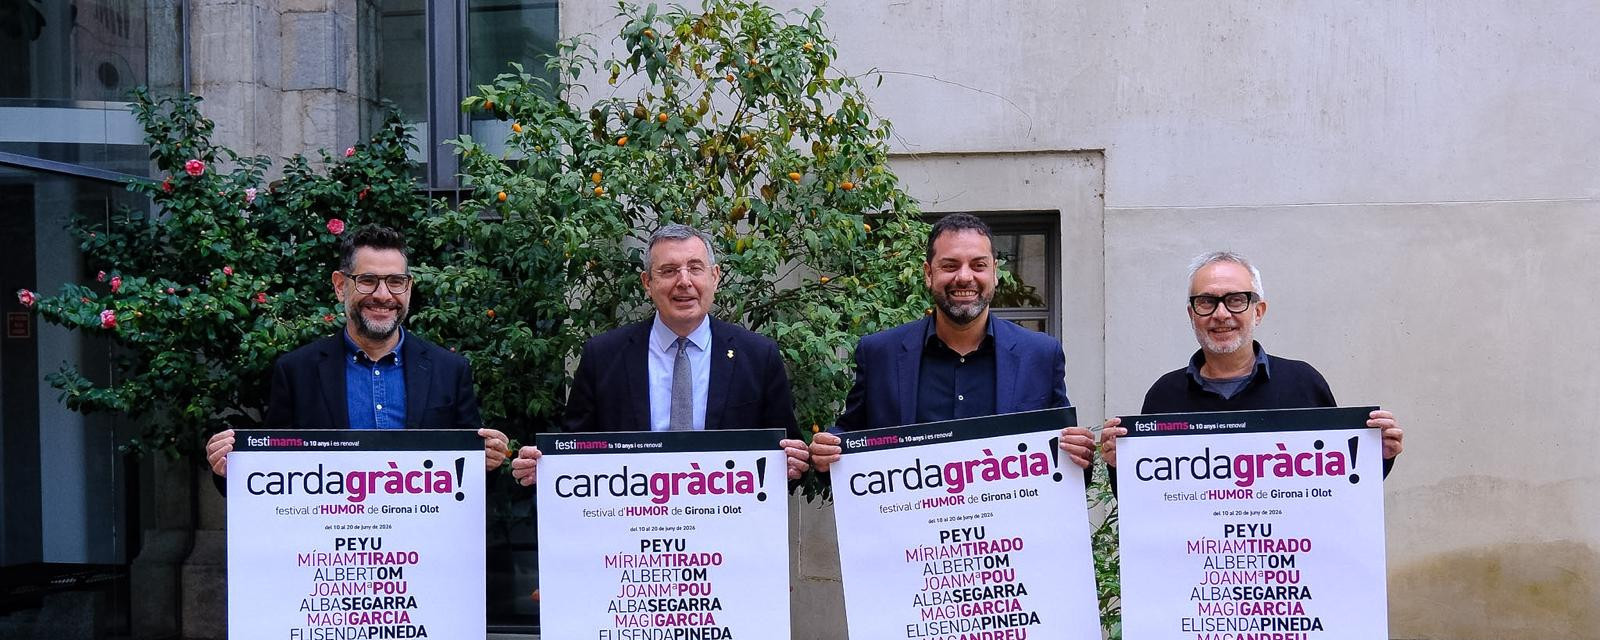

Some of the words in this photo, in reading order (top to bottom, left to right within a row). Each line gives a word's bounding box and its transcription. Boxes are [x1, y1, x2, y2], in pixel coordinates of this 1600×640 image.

[1135, 420, 1188, 432] festimams
[247, 436, 302, 447] festimams
[555, 439, 607, 450] festimams
[846, 434, 898, 449] festimams
[850, 436, 1063, 496] cardagràcia!
[1136, 436, 1360, 487] cardagràcia!
[246, 456, 465, 502] cardagràcia!
[555, 456, 767, 504] cardagràcia!
[880, 502, 912, 514] festival
[915, 495, 964, 510] d'HUMOR
[968, 494, 978, 504] de
[981, 491, 1011, 502] Girona
[1019, 488, 1038, 498] Olot
[1164, 491, 1198, 501] festival
[1200, 489, 1253, 500] d'HUMOR
[1256, 490, 1267, 499] de
[1270, 489, 1303, 498] Girona
[1312, 488, 1332, 497] Olot
[276, 505, 310, 516] festival
[312, 504, 364, 515] d'HUMOR
[368, 504, 378, 514] de
[382, 504, 412, 514] Girona
[420, 504, 439, 513] Olot
[583, 508, 615, 518] festival
[618, 506, 668, 517] d'HUMOR
[672, 506, 682, 516] de
[685, 506, 715, 516] Girona
[723, 506, 742, 514] Olot
[940, 526, 985, 544] PEYU
[1224, 524, 1272, 537] PEYU
[335, 537, 382, 550] PEYU
[641, 539, 686, 552] PEYU
[906, 537, 1023, 563] MÍRIAMTIRADO
[1187, 537, 1312, 554] MÍRIAMTIRADO
[298, 550, 419, 567] MÍRIAMTIRADO
[605, 551, 722, 569] MÍRIAMTIRADO
[923, 554, 1010, 576] ALBERTOM
[1204, 554, 1295, 570] ALBERTOM
[314, 566, 403, 582] ALBERTOM
[621, 568, 707, 583] ALBERTOM
[913, 583, 1027, 607] ALBASEGARRA
[1190, 586, 1312, 602] ALBASEGARRA
[300, 596, 417, 612] ALBASEGARRA
[608, 598, 722, 613] ALBASEGARRA
